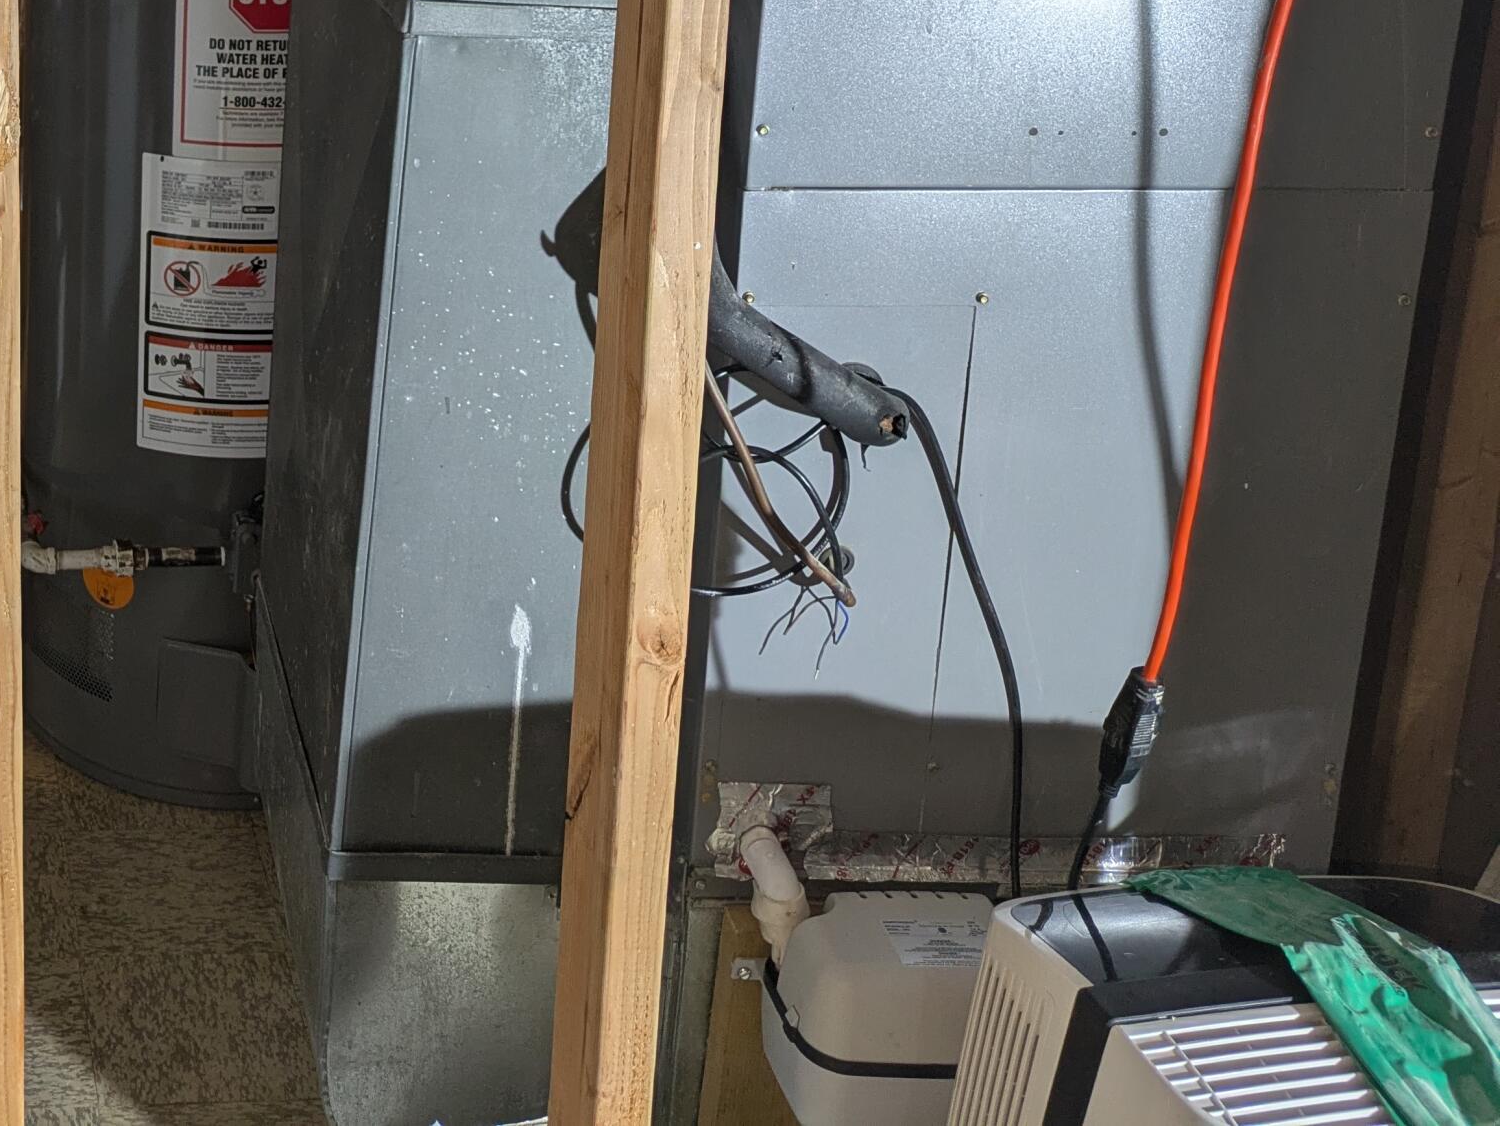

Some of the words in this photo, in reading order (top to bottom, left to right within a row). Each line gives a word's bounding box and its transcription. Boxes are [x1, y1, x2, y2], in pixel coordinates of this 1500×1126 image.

[209, 38, 226, 51] DO
[228, 39, 253, 51] NOT
[217, 52, 257, 65] WATER
[196, 65, 219, 77] THE
[222, 65, 259, 79] PLACE
[263, 67, 280, 79] OF
[198, 244, 245, 253] WARNING
[198, 343, 234, 351] DANGER
